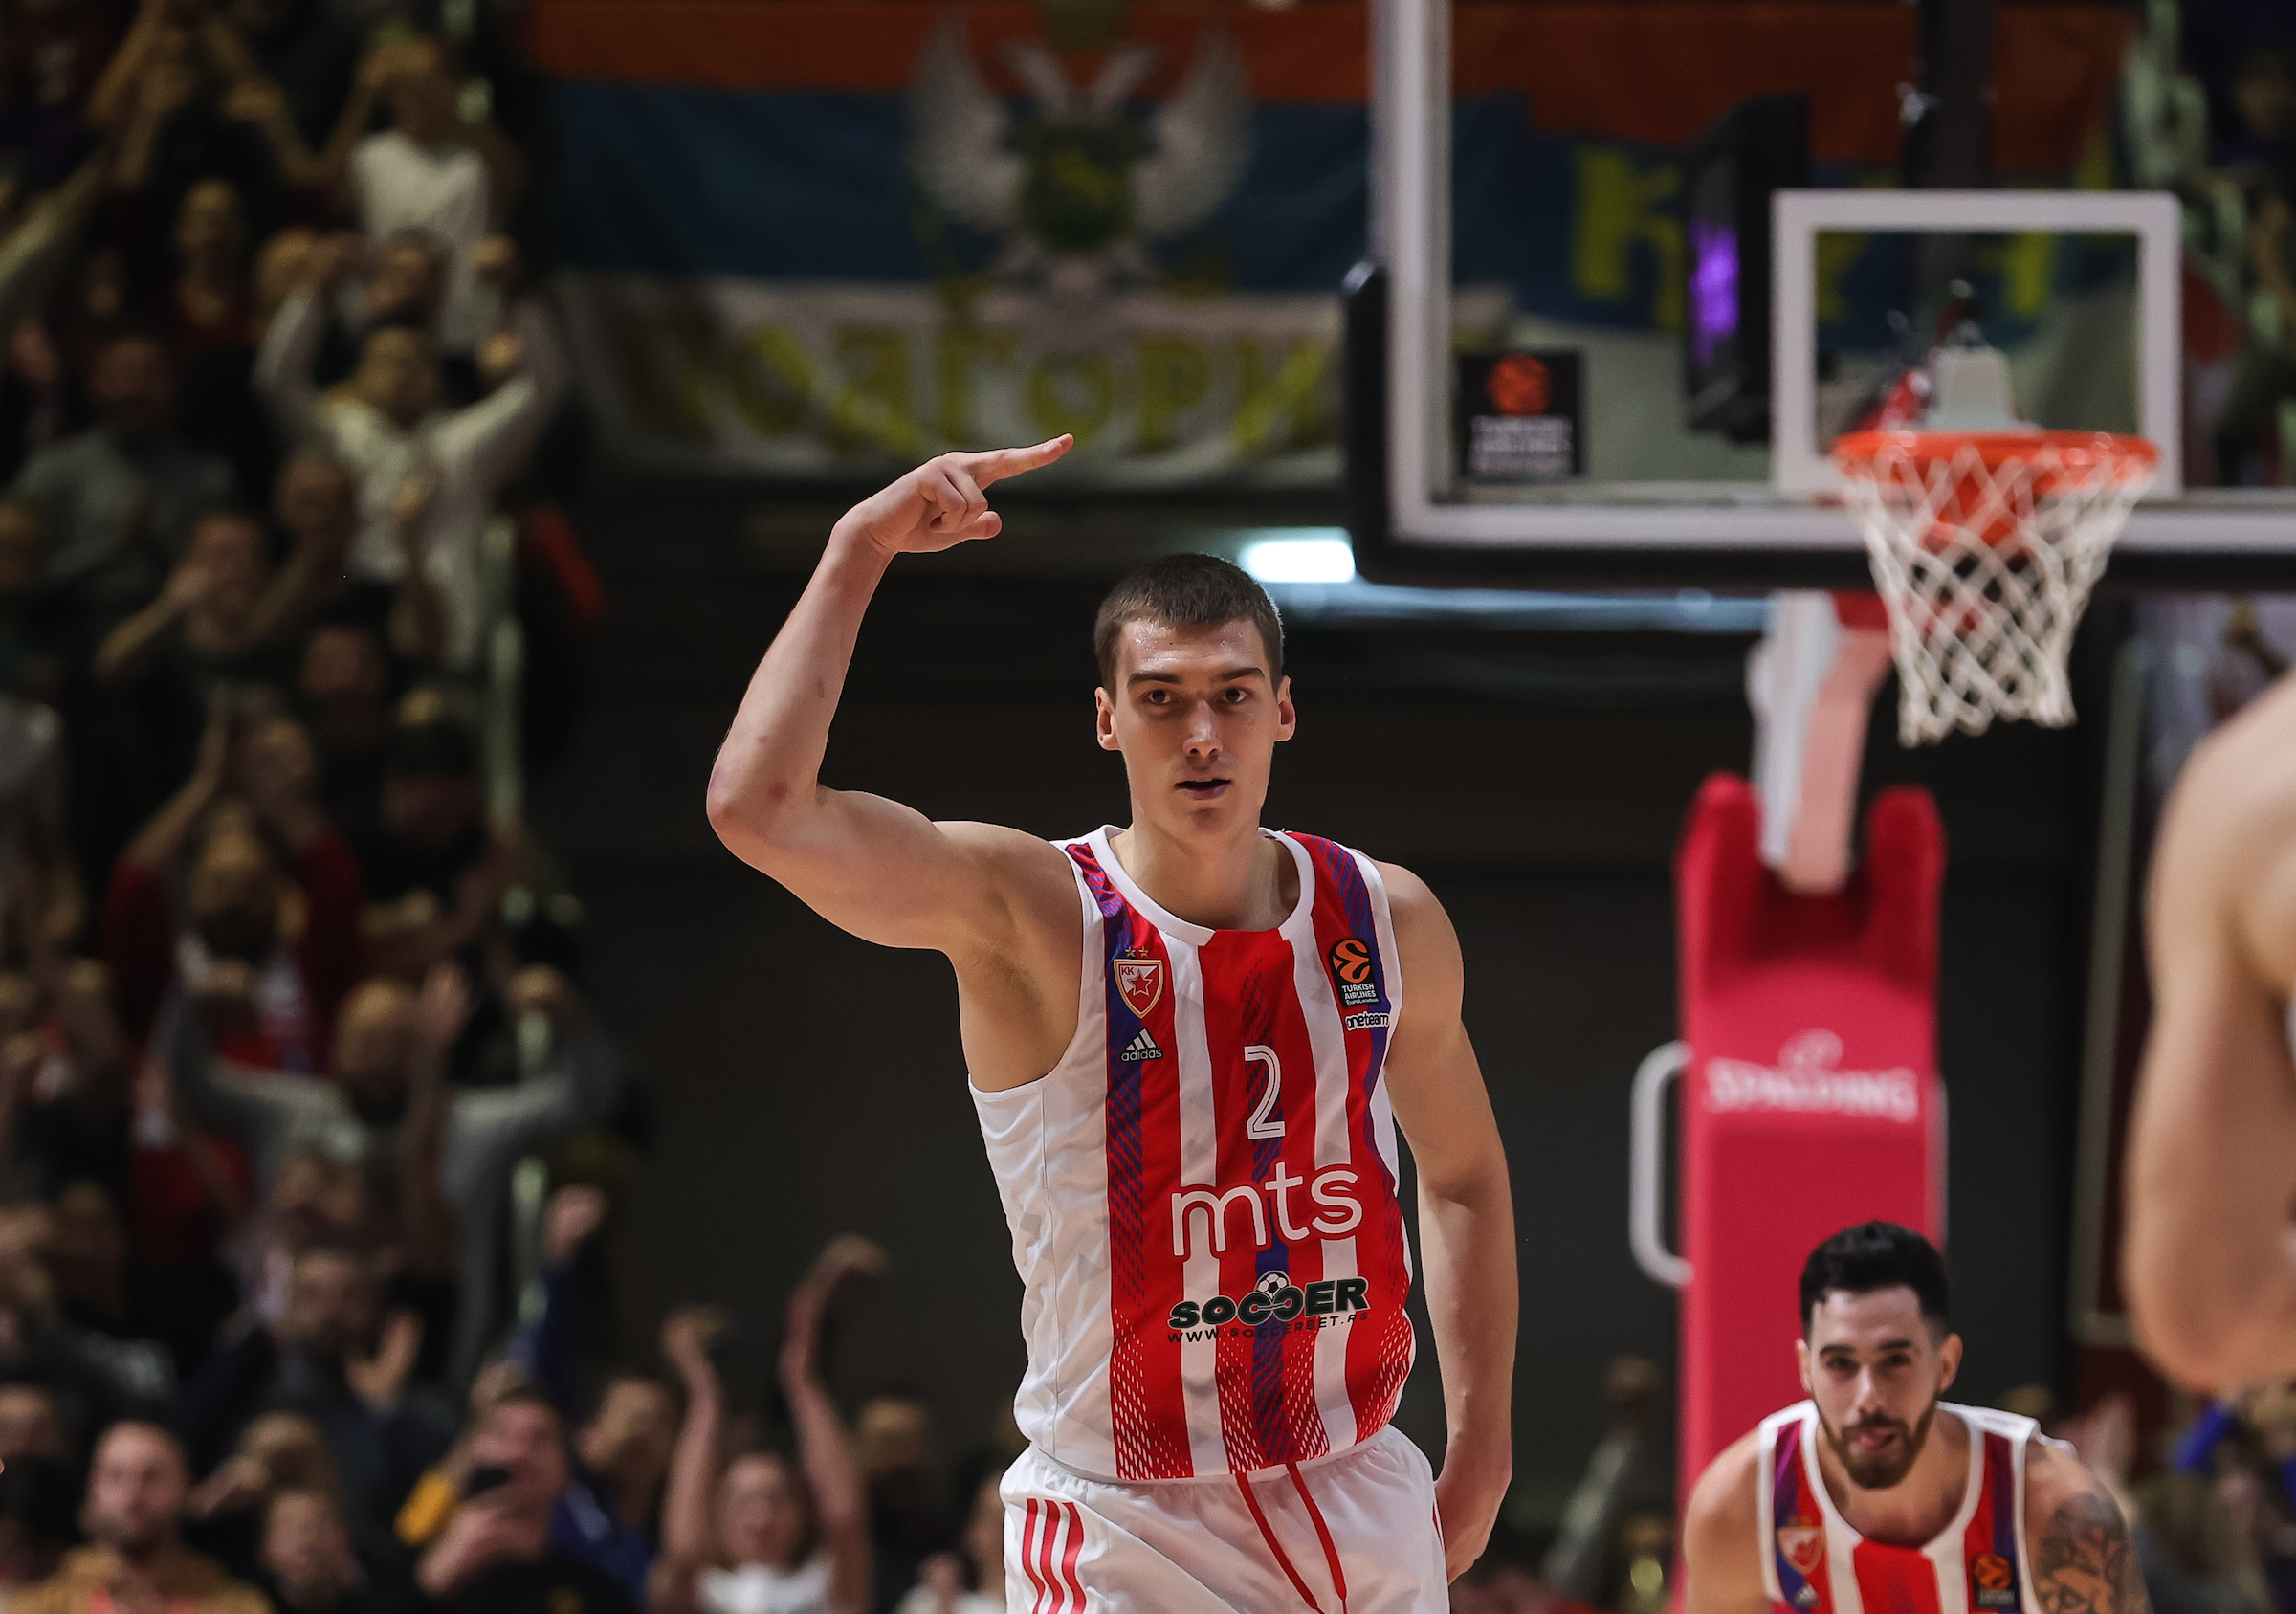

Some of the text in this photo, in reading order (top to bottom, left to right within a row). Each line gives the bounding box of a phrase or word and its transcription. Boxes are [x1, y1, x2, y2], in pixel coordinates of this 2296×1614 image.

[1341, 983, 1375, 993] TURKISH
[1344, 990, 1377, 1001] AIRLINES
[1121, 1049, 1162, 1062] adidas
[1244, 1045, 1286, 1140] 2
[1171, 1161, 1363, 1256] mts
[1168, 1276, 1371, 1329] SOCCER
